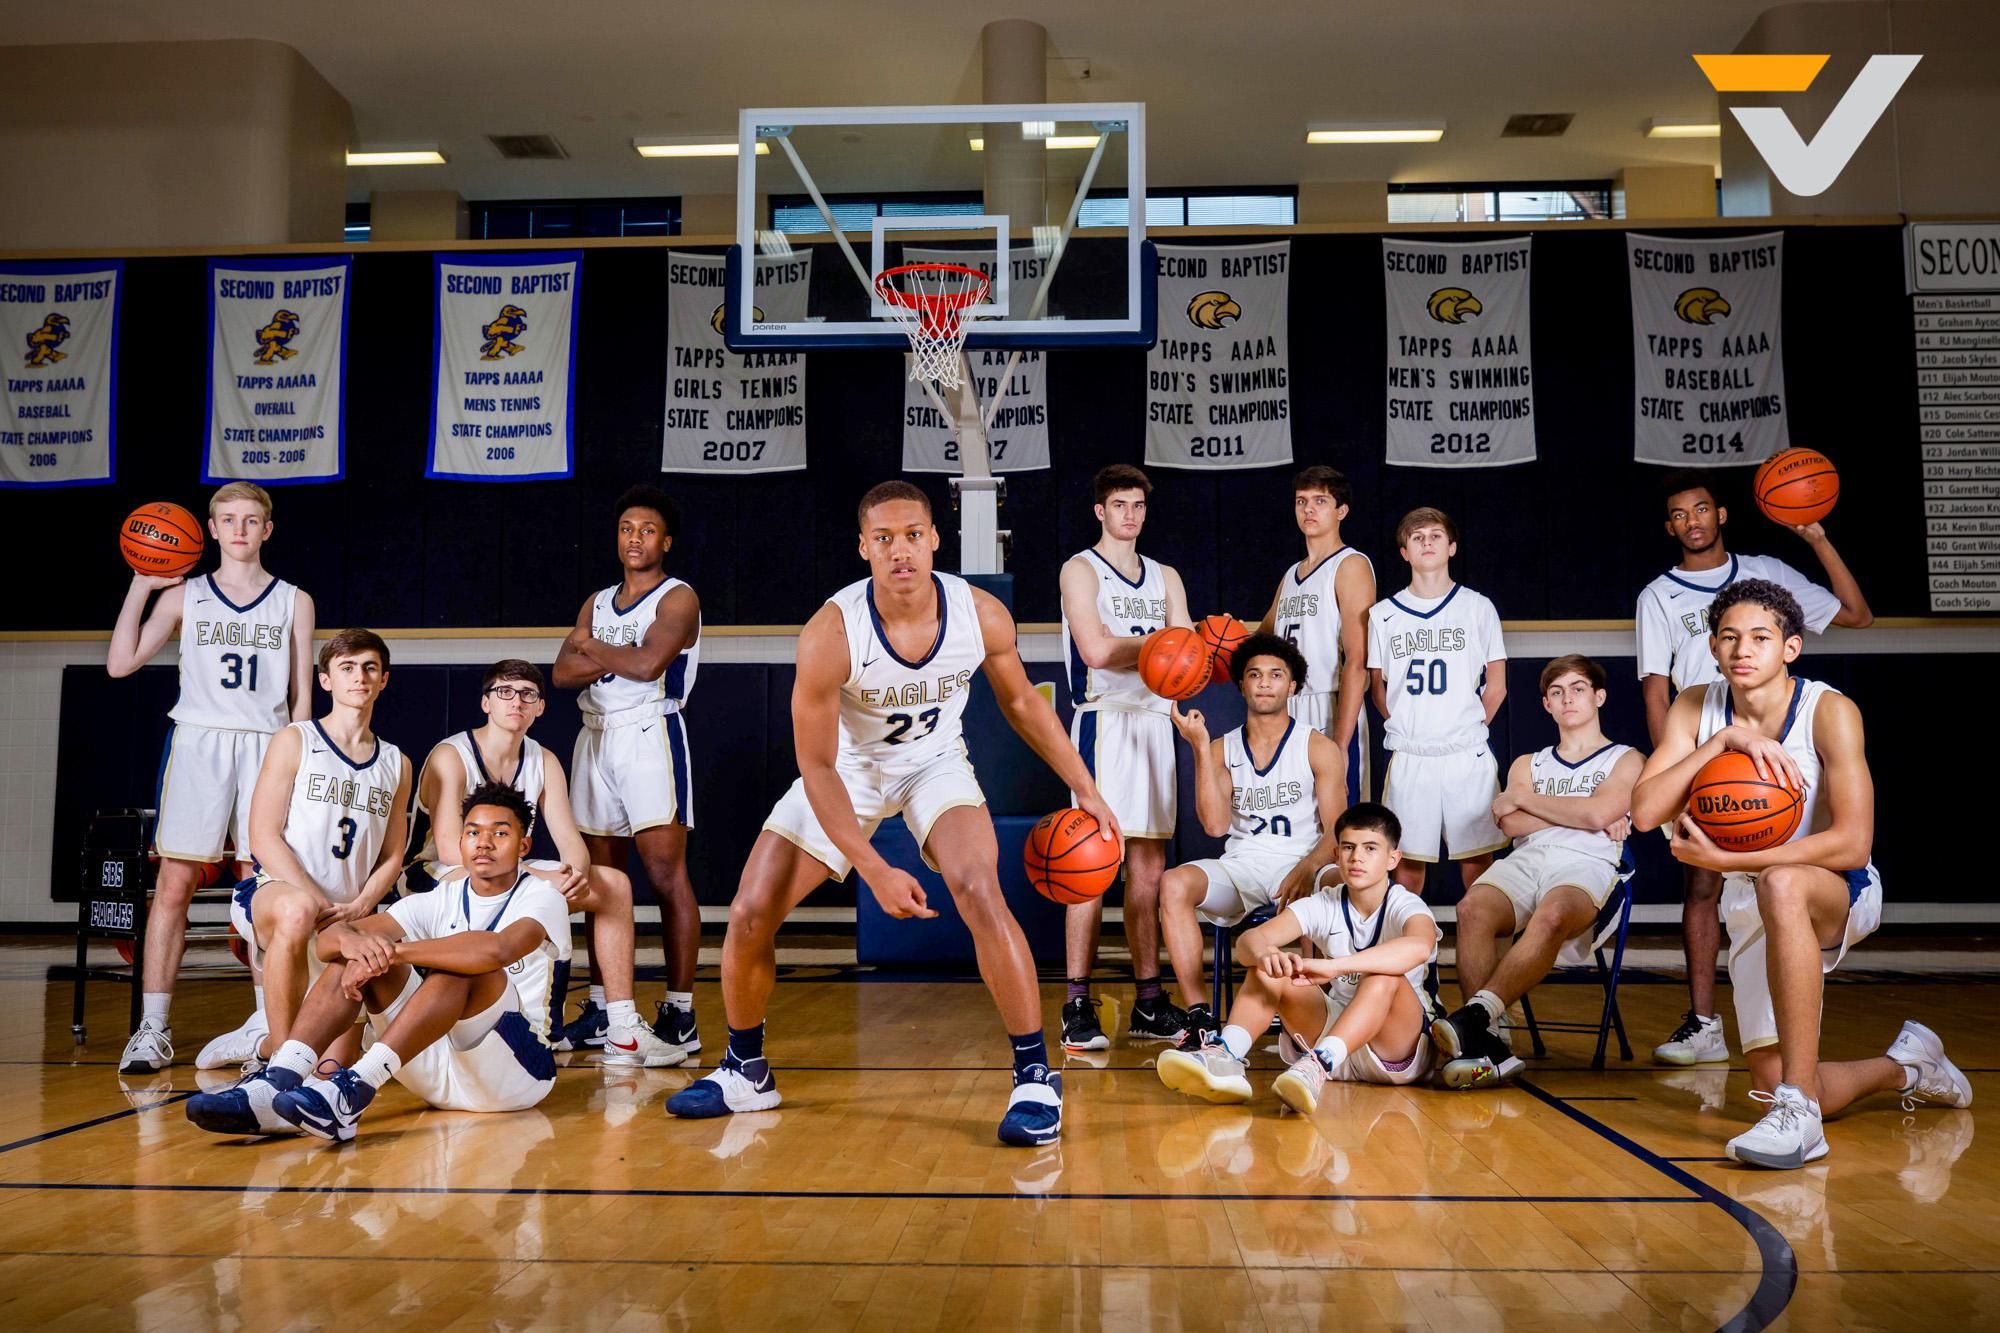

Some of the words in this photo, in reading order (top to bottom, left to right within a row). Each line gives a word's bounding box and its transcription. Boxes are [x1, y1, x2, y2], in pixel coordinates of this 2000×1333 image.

[1158, 256, 1207, 279] ECOND
[1222, 253, 1287, 278] BAPTIST
[1387, 251, 1447, 274] SECOND
[1462, 250, 1528, 274] BAPTIST
[1634, 248, 1695, 274] SECOND
[1709, 246, 1776, 273] BAPTIST
[1920, 238, 2000, 275] SECON
[670, 264, 726, 287] SECOND
[755, 261, 808, 287] APTIST
[979, 258, 1047, 281] BATIST
[0, 283, 46, 303] ECOND
[54, 280, 112, 303] BAPTIST
[220, 278, 275, 300] SECOND
[283, 276, 342, 299] BAPTIST
[447, 274, 502, 295] SECOND
[511, 272, 570, 295] BAPTIST
[1945, 298, 1991, 309] Basketball
[1938, 318, 1973, 327] Graham
[1975, 317, 2000, 329] Aycoc
[1160, 339, 1212, 363] TAPPS
[1231, 336, 1277, 361] AAAA
[1399, 336, 1452, 358] TAPPS
[1471, 335, 1519, 358] AAAA
[1648, 334, 1702, 358] TAPPS
[1722, 332, 1770, 358] AAAA
[1939, 336, 1950, 345] RJ
[675, 347, 725, 368] TAPPS
[1942, 354, 1967, 364] Jacob
[1969, 354, 1998, 366] Skyles
[8, 379, 43, 393] TAPPS
[46, 377, 85, 392] AAAAA
[236, 375, 273, 390] TAPPS
[276, 374, 316, 389] AAAAA
[464, 371, 500, 386] TAPPS
[503, 370, 544, 385] AAAAA
[674, 378, 722, 400] GIRLS
[740, 375, 797, 399] TENNIS
[1150, 370, 1196, 392] BOY'S
[1209, 368, 1287, 393] SWIMMING
[1389, 367, 1436, 389] MEN'S
[1450, 366, 1530, 389] SWIMMING
[1665, 367, 1754, 390] BASEBALL
[1943, 373, 1968, 385] Elijah
[464, 397, 496, 412] MENS
[501, 396, 540, 412] TENNIS
[1944, 392, 1962, 400] Alec
[18, 404, 71, 419] BASEBALL
[255, 401, 295, 416] OVERALL
[667, 408, 709, 430] STATE
[727, 405, 803, 430] CHAMPIONS
[1150, 402, 1194, 425] STATE
[1209, 399, 1288, 426] CHAMPIONS
[1389, 399, 1433, 421] STATE
[1450, 397, 1530, 421] CHAMPIONS
[1641, 397, 1684, 422] STATE
[1700, 395, 1781, 423] CHAMPIONS
[1945, 410, 1981, 420] Dominic
[0, 431, 24, 445] TATE
[28, 429, 93, 445] CHAMPIONS
[224, 427, 256, 443] STATE
[258, 425, 325, 443] CHAMPIONS
[452, 423, 482, 438] STATE
[486, 422, 552, 439] CHAMPIONS
[1946, 428, 1965, 438] Cole
[486, 447, 515, 460] 2006
[704, 440, 766, 461] 2007
[1190, 435, 1244, 457] 2011
[1430, 433, 1491, 454] 2012
[1683, 432, 1744, 454] 2014
[1947, 447, 1978, 457] Jordan
[30, 453, 57, 467] 2006
[1948, 466, 1972, 478] Harry
[1949, 485, 1979, 494] Garrett
[1950, 503, 1984, 513] Jackson
[129, 519, 180, 547] Wilson
[1952, 522, 1977, 531] Kevin
[1952, 541, 1976, 551] Grant
[1953, 560, 1978, 572] Elijah
[1933, 579, 1959, 589] Coach
[1962, 579, 1997, 589] Mouton
[1935, 597, 1961, 607] Coach
[1964, 597, 1991, 608] Scipio
[196, 621, 282, 650] EAGLES
[1391, 628, 1465, 659] EAGLES
[220, 653, 257, 691] 31
[1406, 659, 1447, 695] 50
[861, 670, 971, 708] EAGLES
[883, 707, 941, 745] 23
[307, 773, 392, 818] EAGLES
[1232, 781, 1302, 811] EAGLES
[1697, 795, 1768, 814] Wilson
[332, 816, 357, 860] 3
[1711, 826, 1773, 844] VOLUTION
[102, 861, 123, 887] SBS
[91, 901, 134, 929] EAGLES
